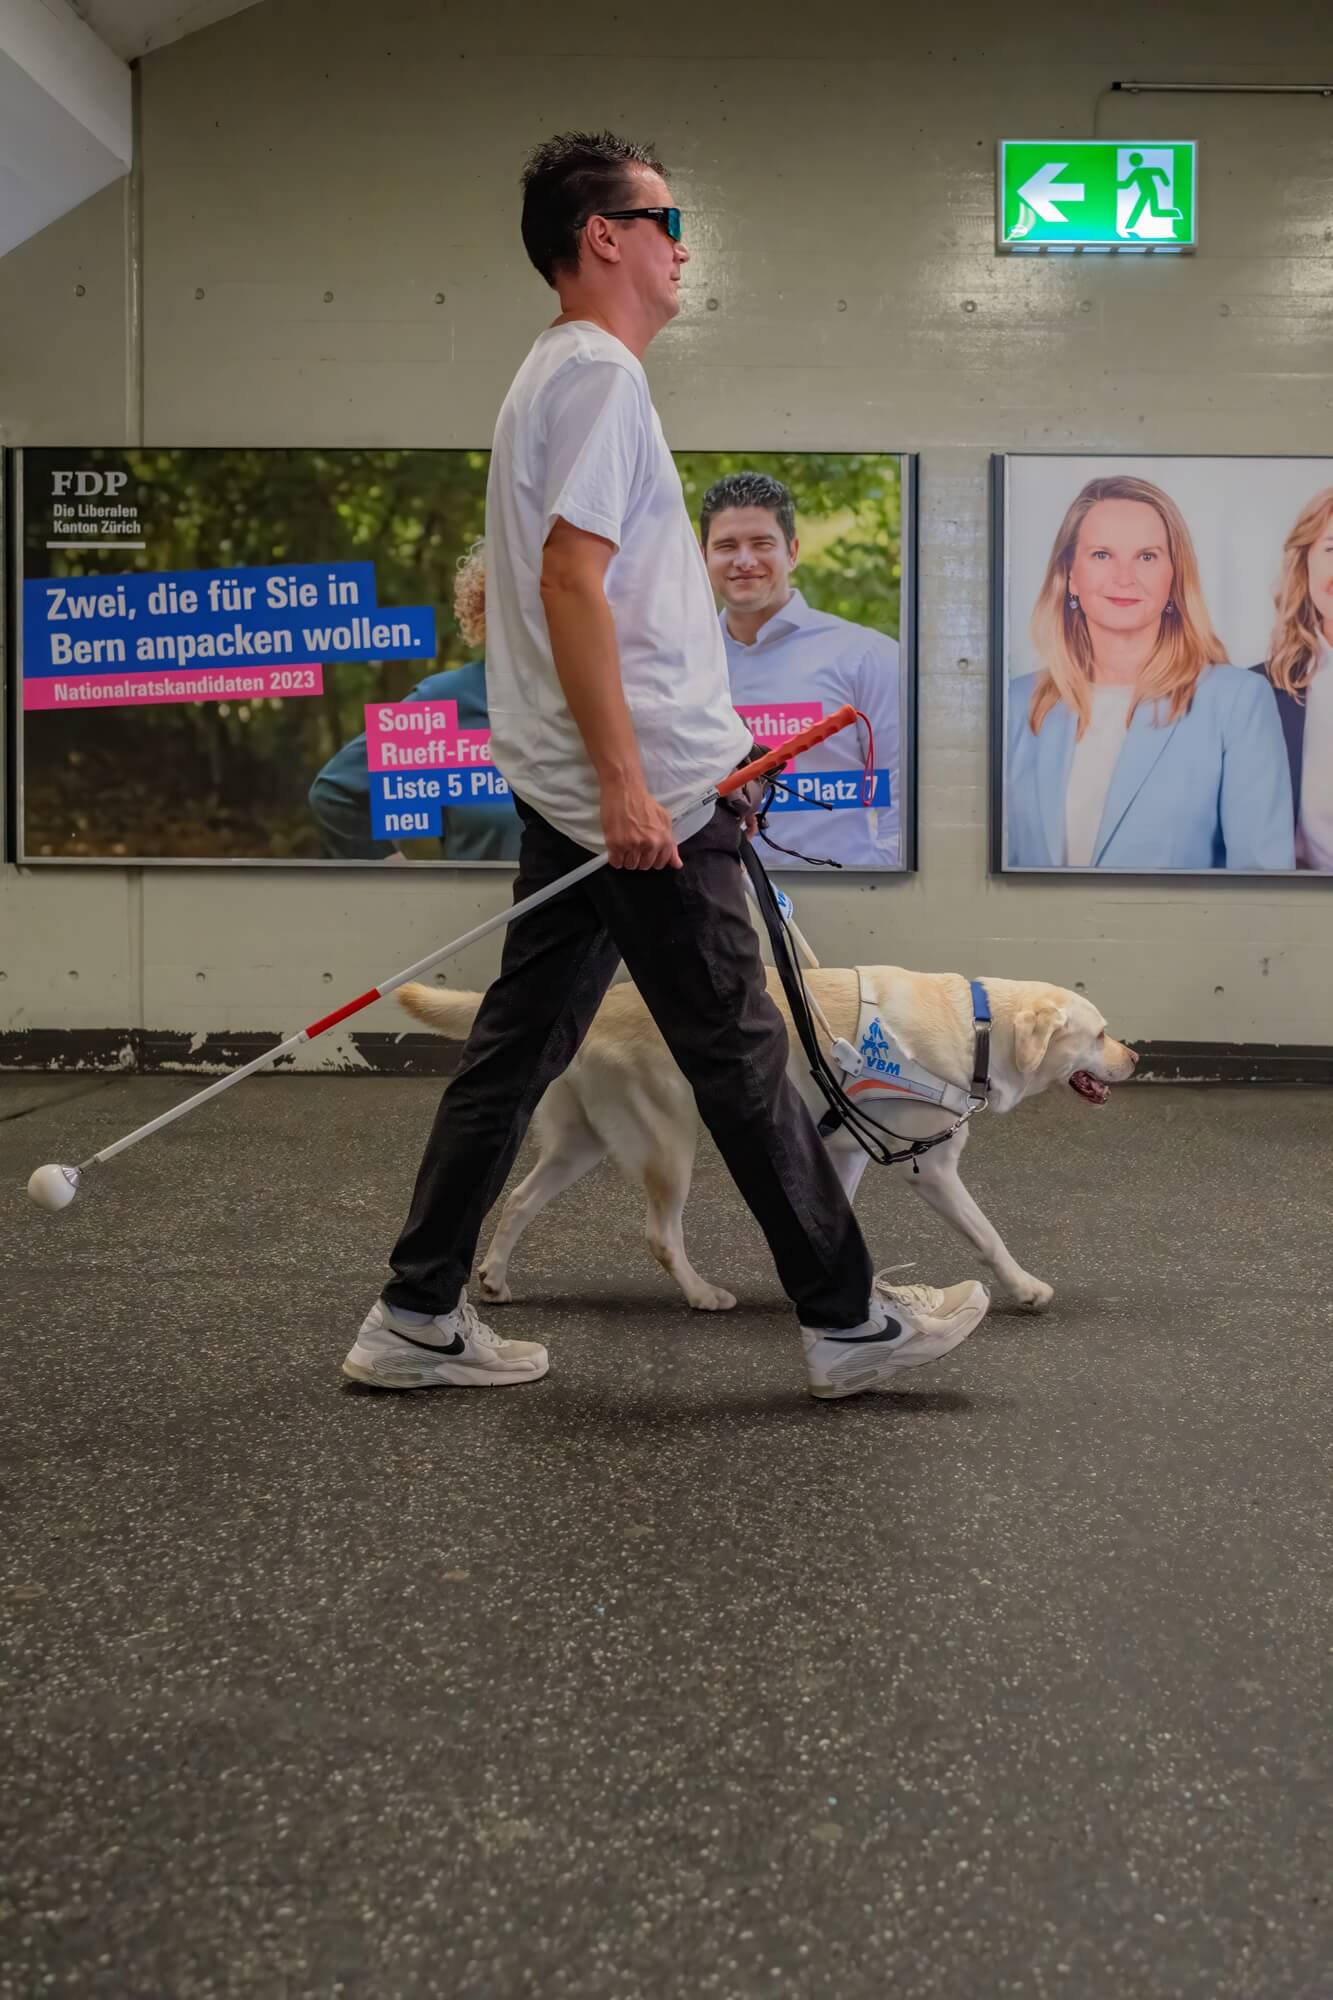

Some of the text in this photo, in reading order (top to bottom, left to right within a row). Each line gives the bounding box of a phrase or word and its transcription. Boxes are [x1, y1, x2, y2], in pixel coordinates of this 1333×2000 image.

[51, 471, 128, 496] FDP
[53, 503, 137, 518] Die Liberalen
[53, 520, 142, 534] Kanton Zürich
[46, 574, 359, 621] Zwei, die für Sie in
[50, 617, 421, 666] Bern anpacken wollen.
[54, 670, 315, 701] Nationalratskandidaten 2023
[378, 707, 446, 735] Sonja
[745, 712, 815, 737] tthias
[381, 739, 492, 766] Rueff-Fre
[383, 772, 509, 800] Liste 5 Pla
[774, 779, 789, 803] 5
[797, 777, 858, 802] Platz
[385, 812, 430, 831] neu
[867, 1055, 900, 1076] VBM
